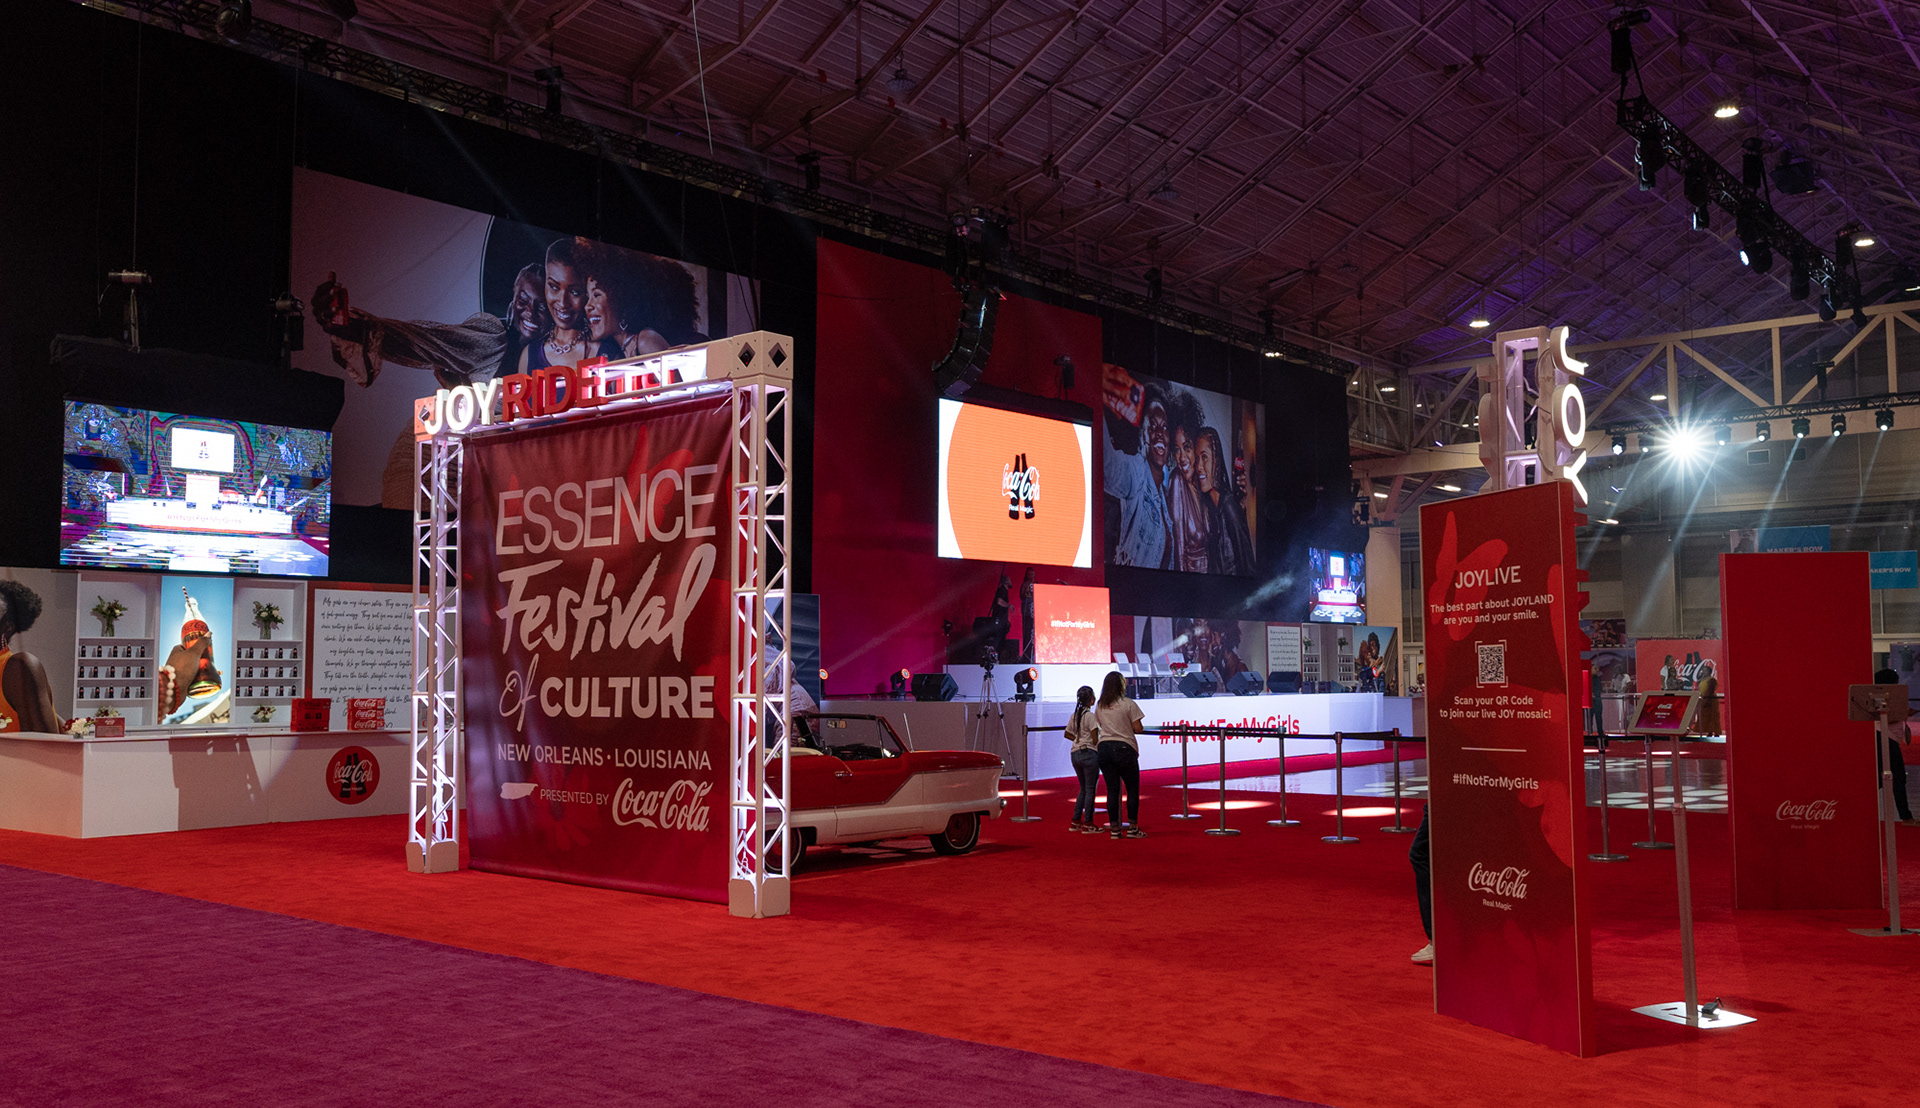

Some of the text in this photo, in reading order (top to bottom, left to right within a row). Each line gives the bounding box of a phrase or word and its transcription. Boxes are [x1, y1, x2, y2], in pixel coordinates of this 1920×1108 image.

[424, 356, 608, 435] JOYRIDE
[495, 464, 718, 556] ESSENCE
[1454, 566, 1522, 589] JOYLIVE
[496, 543, 717, 662] Festival
[1431, 594, 1554, 613] The best part about JOYLAND
[1444, 610, 1540, 626] are you and your smile.
[498, 653, 714, 732] Of CULTURE
[1454, 696, 1533, 707] Scan your QR Code
[1440, 709, 1448, 718] to
[1449, 709, 1464, 719] join
[1481, 709, 1497, 718] live
[1498, 709, 1515, 718] JOY
[1517, 709, 1552, 719] mosaic!
[498, 743, 712, 771] NEW ORLEANS LOUISIANA
[1453, 773, 1539, 790] #IfNotForMyGirls
[540, 778, 714, 832] PRESENTED BY Coca-Cola
[1776, 800, 1838, 820] Coca-Cola
[1468, 862, 1530, 899] Coca-Cola
[1483, 899, 1512, 911] Real Magic
